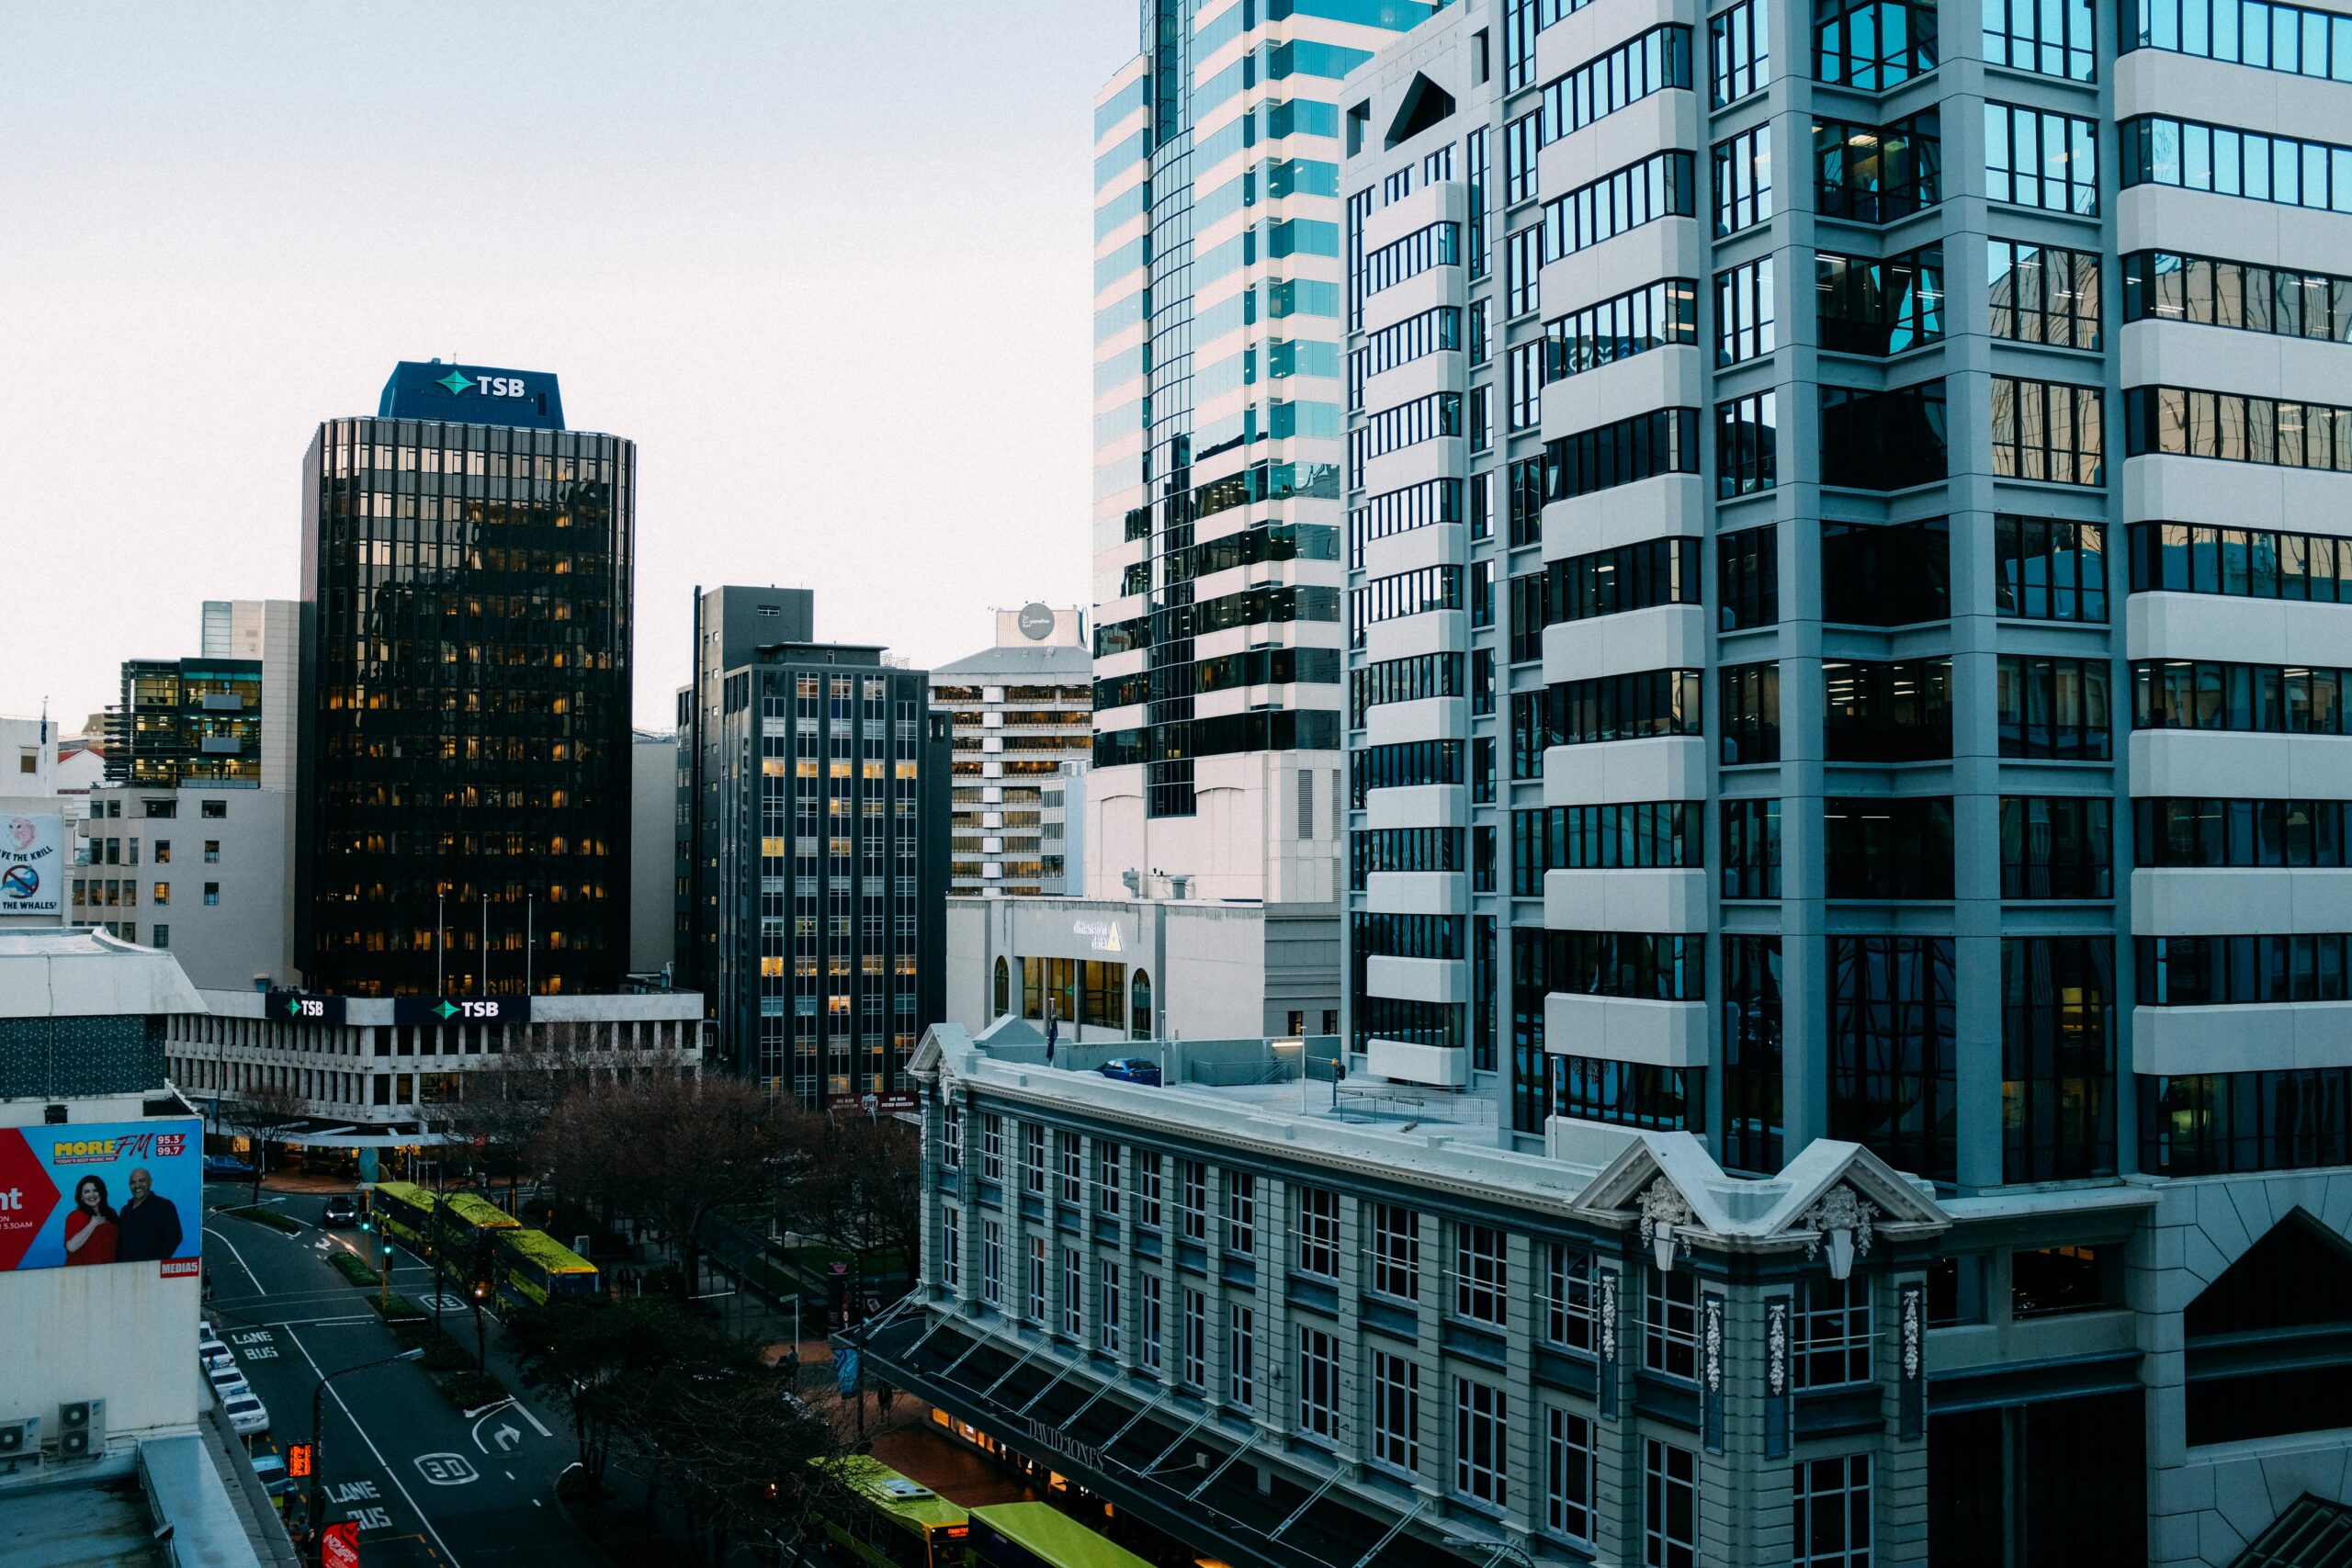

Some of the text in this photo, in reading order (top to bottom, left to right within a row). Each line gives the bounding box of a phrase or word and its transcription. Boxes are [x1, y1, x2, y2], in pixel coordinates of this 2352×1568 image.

[477, 375, 525, 398] TSB
[13, 853, 28, 862] THE
[29, 846, 53, 861] KRILL
[301, 999, 323, 1017] TSB
[461, 1001, 499, 1018] TSB
[54, 1133, 154, 1159] MORE FM
[157, 1134, 180, 1145] 95.3
[157, 1146, 180, 1156] 99.7
[161, 1262, 198, 1274] MEDIA5
[232, 1331, 274, 1345] LANE
[243, 1346, 279, 1360] BUS
[1029, 1416, 1104, 1472] DAVID JONES
[426, 1459, 467, 1479] 30
[322, 1480, 380, 1504] LANE
